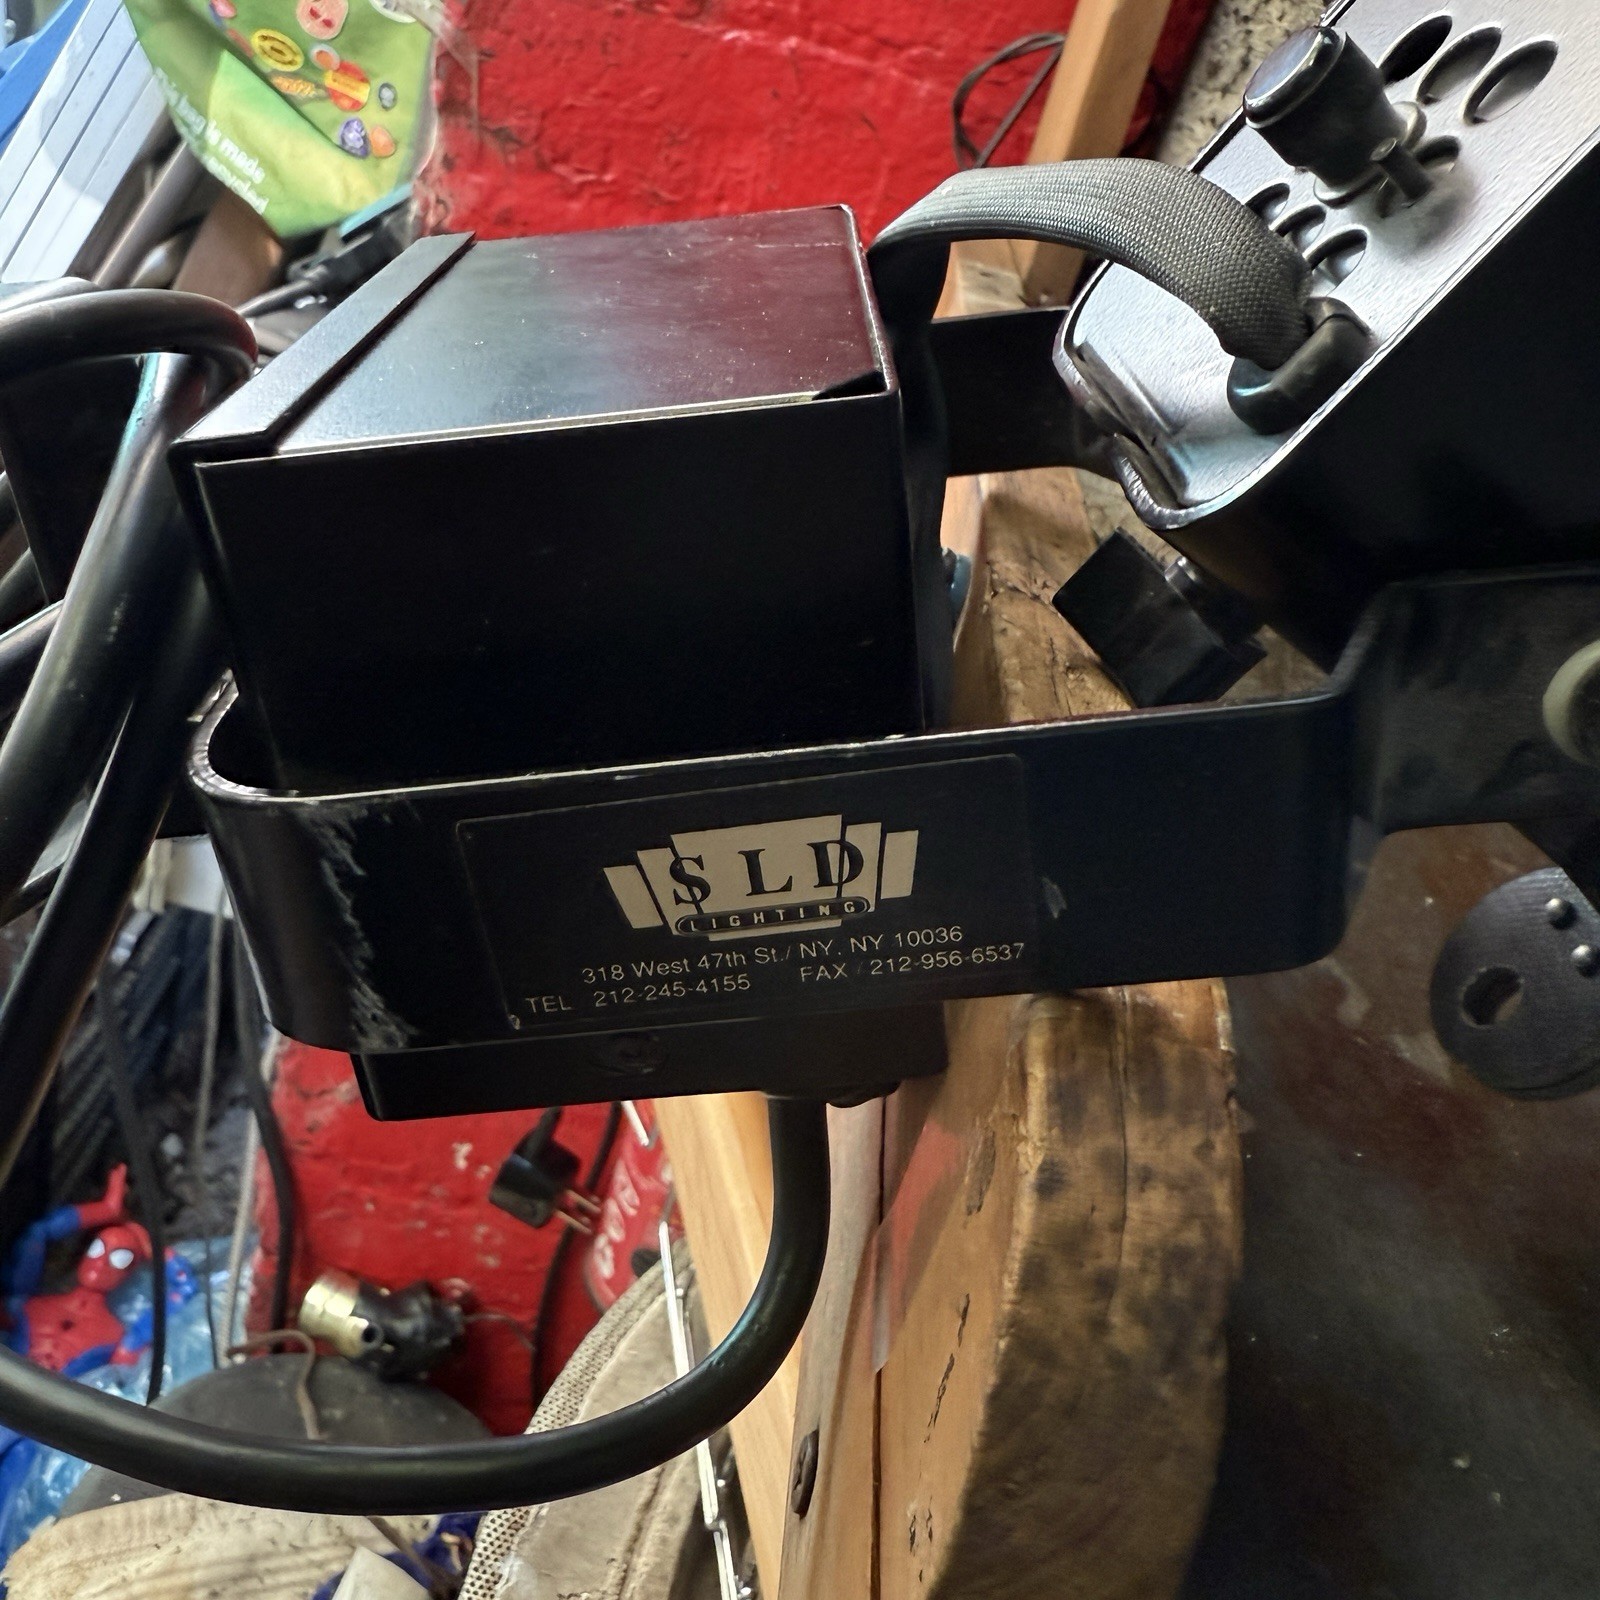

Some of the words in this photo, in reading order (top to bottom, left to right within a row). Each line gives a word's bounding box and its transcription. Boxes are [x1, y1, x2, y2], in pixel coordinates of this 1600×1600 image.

[219, 137, 266, 184] made
[669, 839, 864, 906] SLD
[690, 900, 856, 933] LIGHTING
[581, 964, 625, 984] 318
[631, 958, 691, 979] West
[697, 951, 746, 969] 47th
[850, 933, 884, 953] NY
[894, 925, 963, 948] 10036
[800, 962, 849, 983] FAX
[869, 942, 1025, 976] 212-956-6537
[525, 995, 573, 1014] TEL
[593, 973, 751, 1008] 212-245-4155
